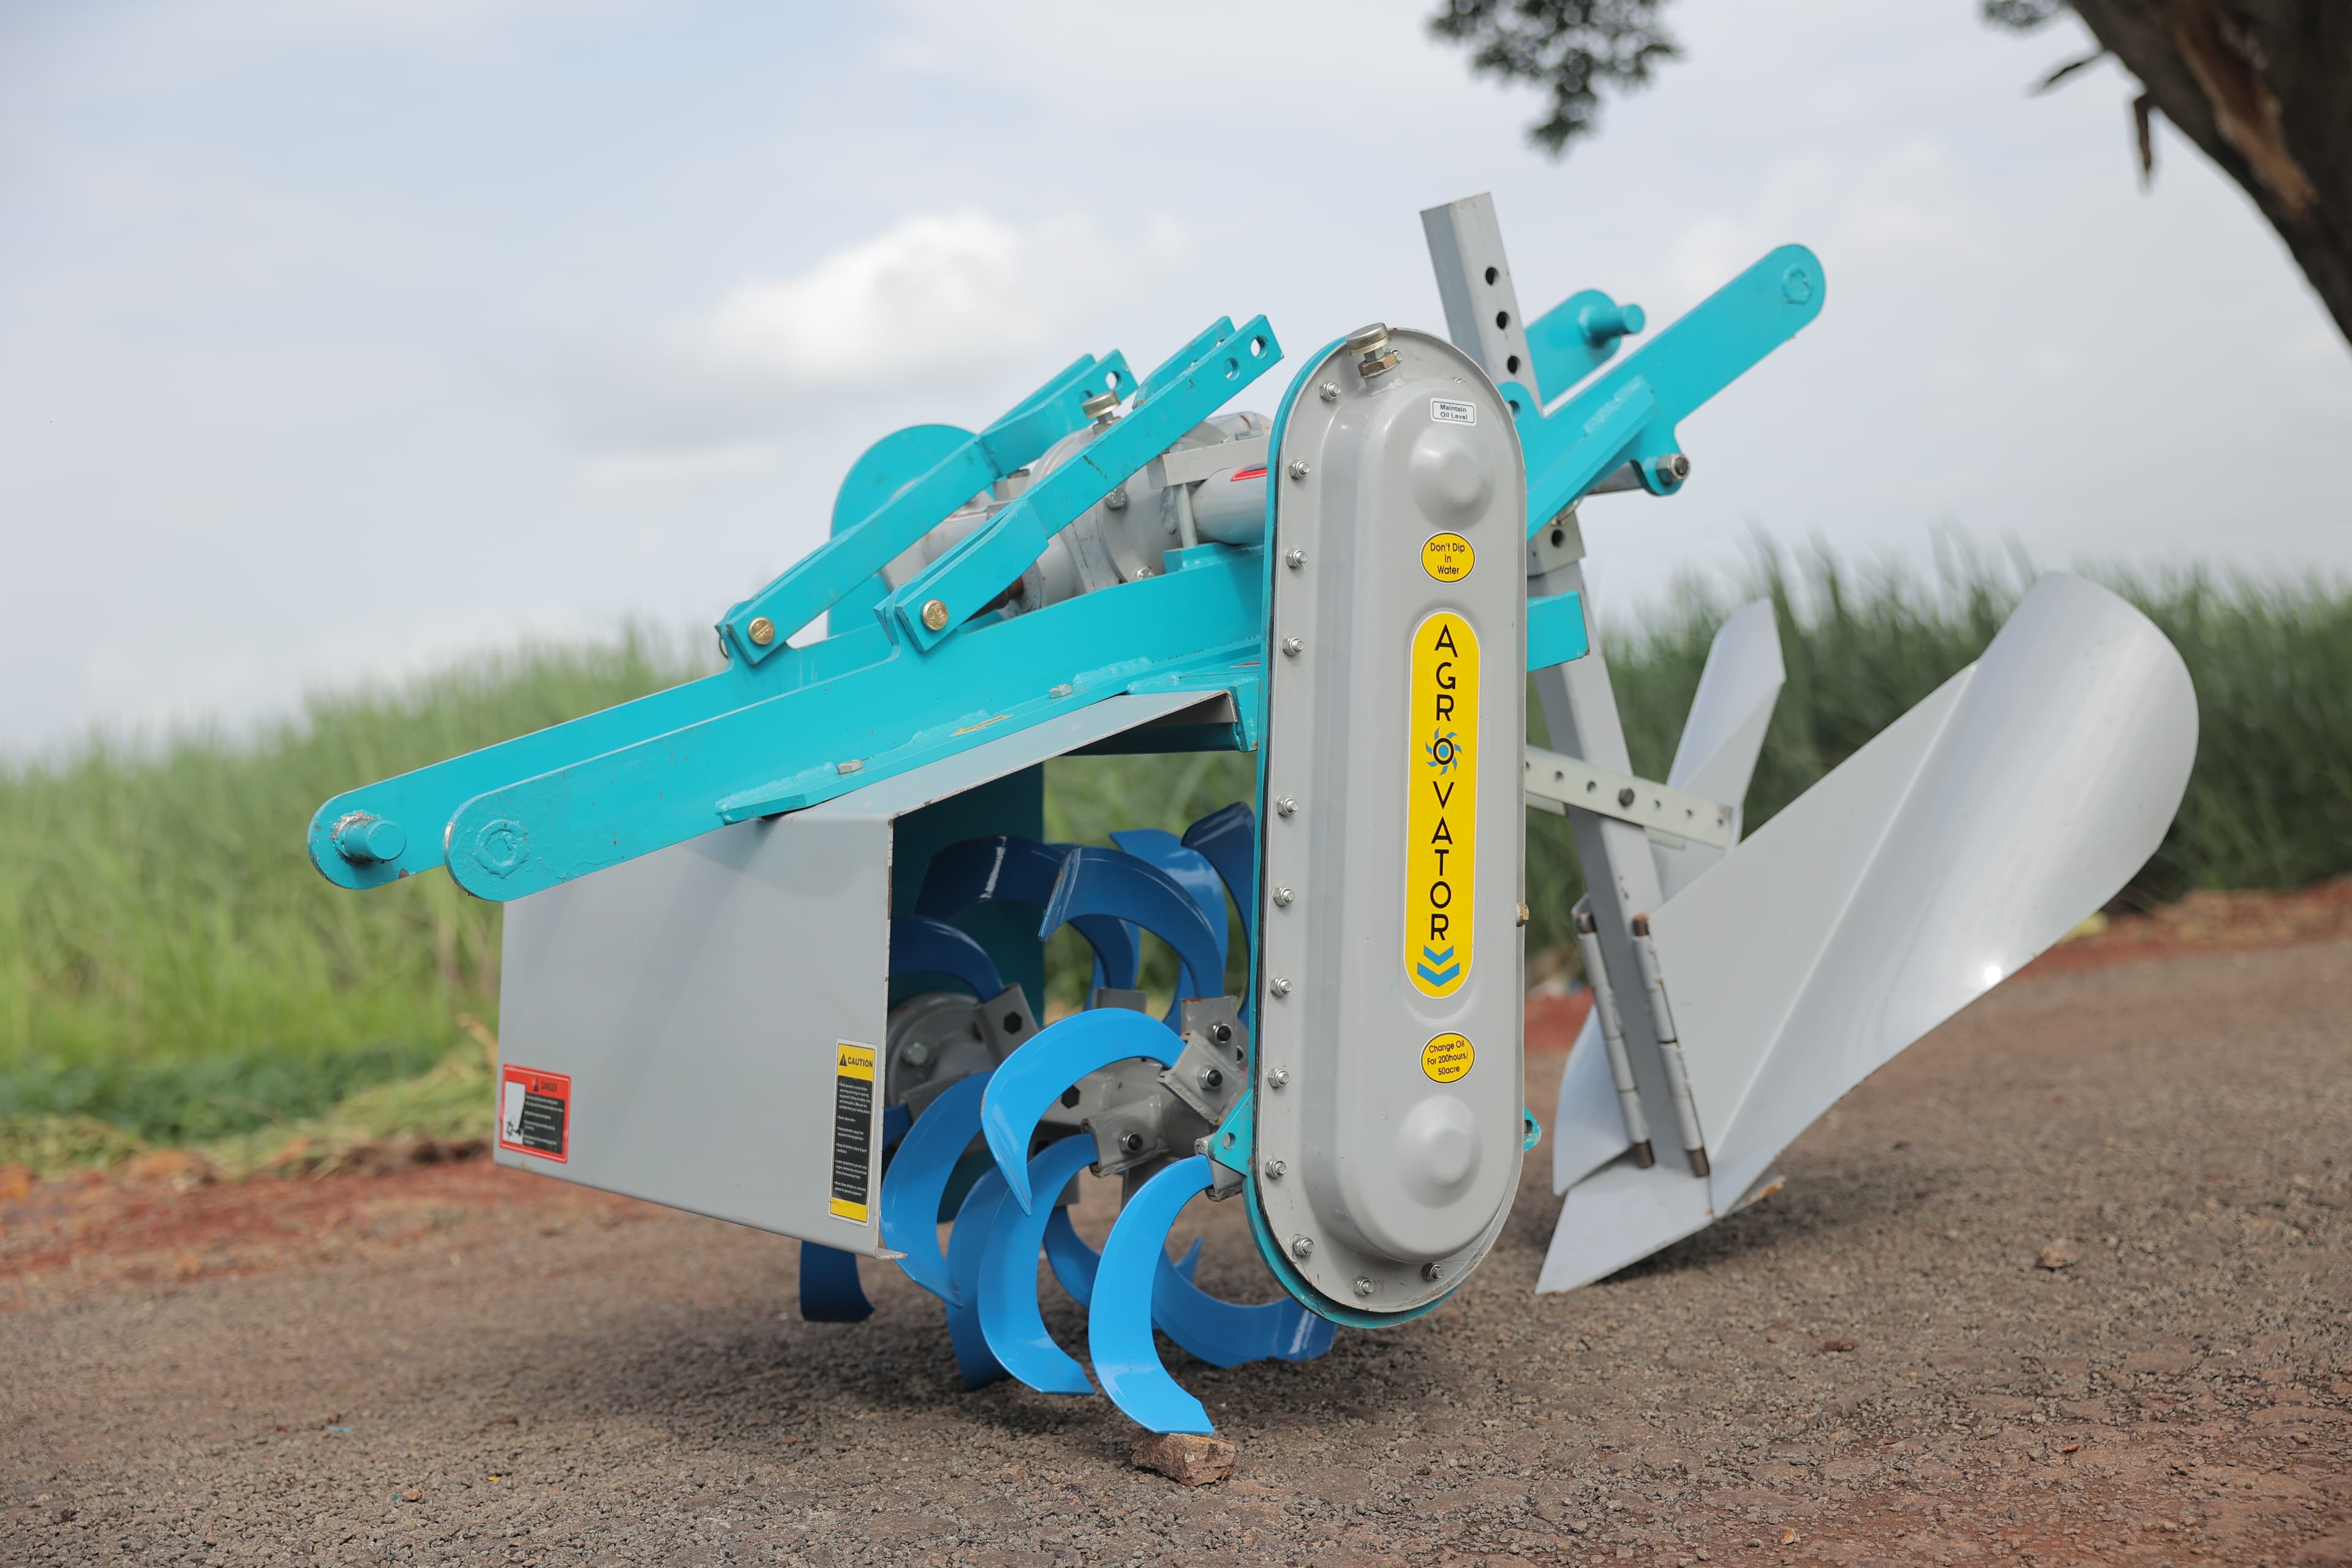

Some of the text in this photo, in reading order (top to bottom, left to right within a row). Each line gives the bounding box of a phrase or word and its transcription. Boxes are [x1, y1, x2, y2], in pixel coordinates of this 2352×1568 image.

[1430, 543, 1465, 554] Don't Dip
[1444, 554, 1452, 563] In
[1437, 565, 1460, 575] Water
[1430, 623, 1458, 941] AGROVATOR
[1429, 1039, 1465, 1053] Change Oil
[1438, 1050, 1469, 1063] 200hours/
[848, 1057, 873, 1068] CAUTION
[1438, 1066, 1460, 1076] 50acre
